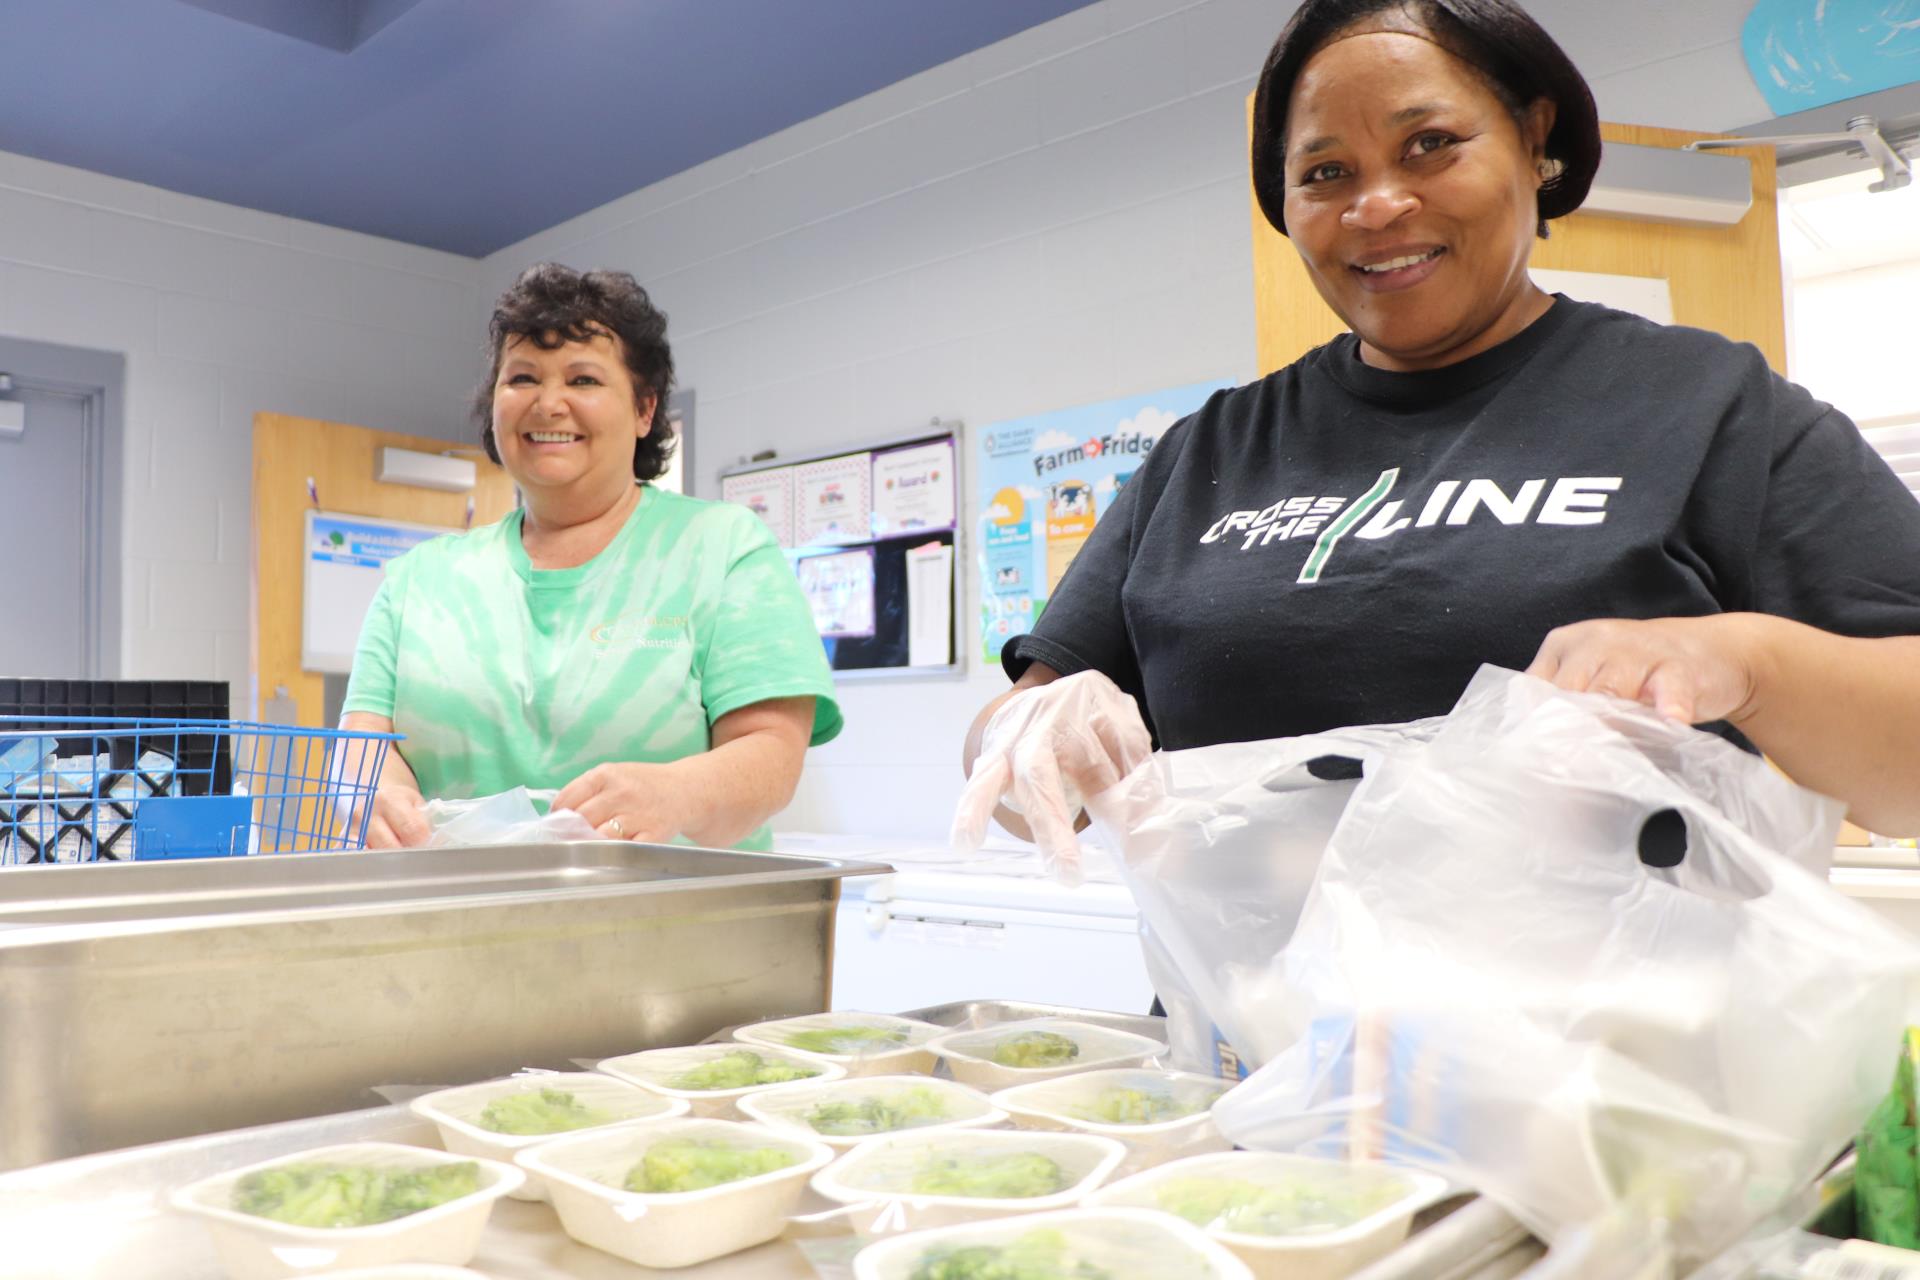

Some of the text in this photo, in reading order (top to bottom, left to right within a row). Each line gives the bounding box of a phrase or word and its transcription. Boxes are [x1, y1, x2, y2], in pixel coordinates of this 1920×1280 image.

[1034, 432, 1153, 475] Farm Fridg
[1200, 496, 1346, 543] CROSS
[1354, 477, 1623, 539] LINE
[1241, 515, 1329, 550] THE
